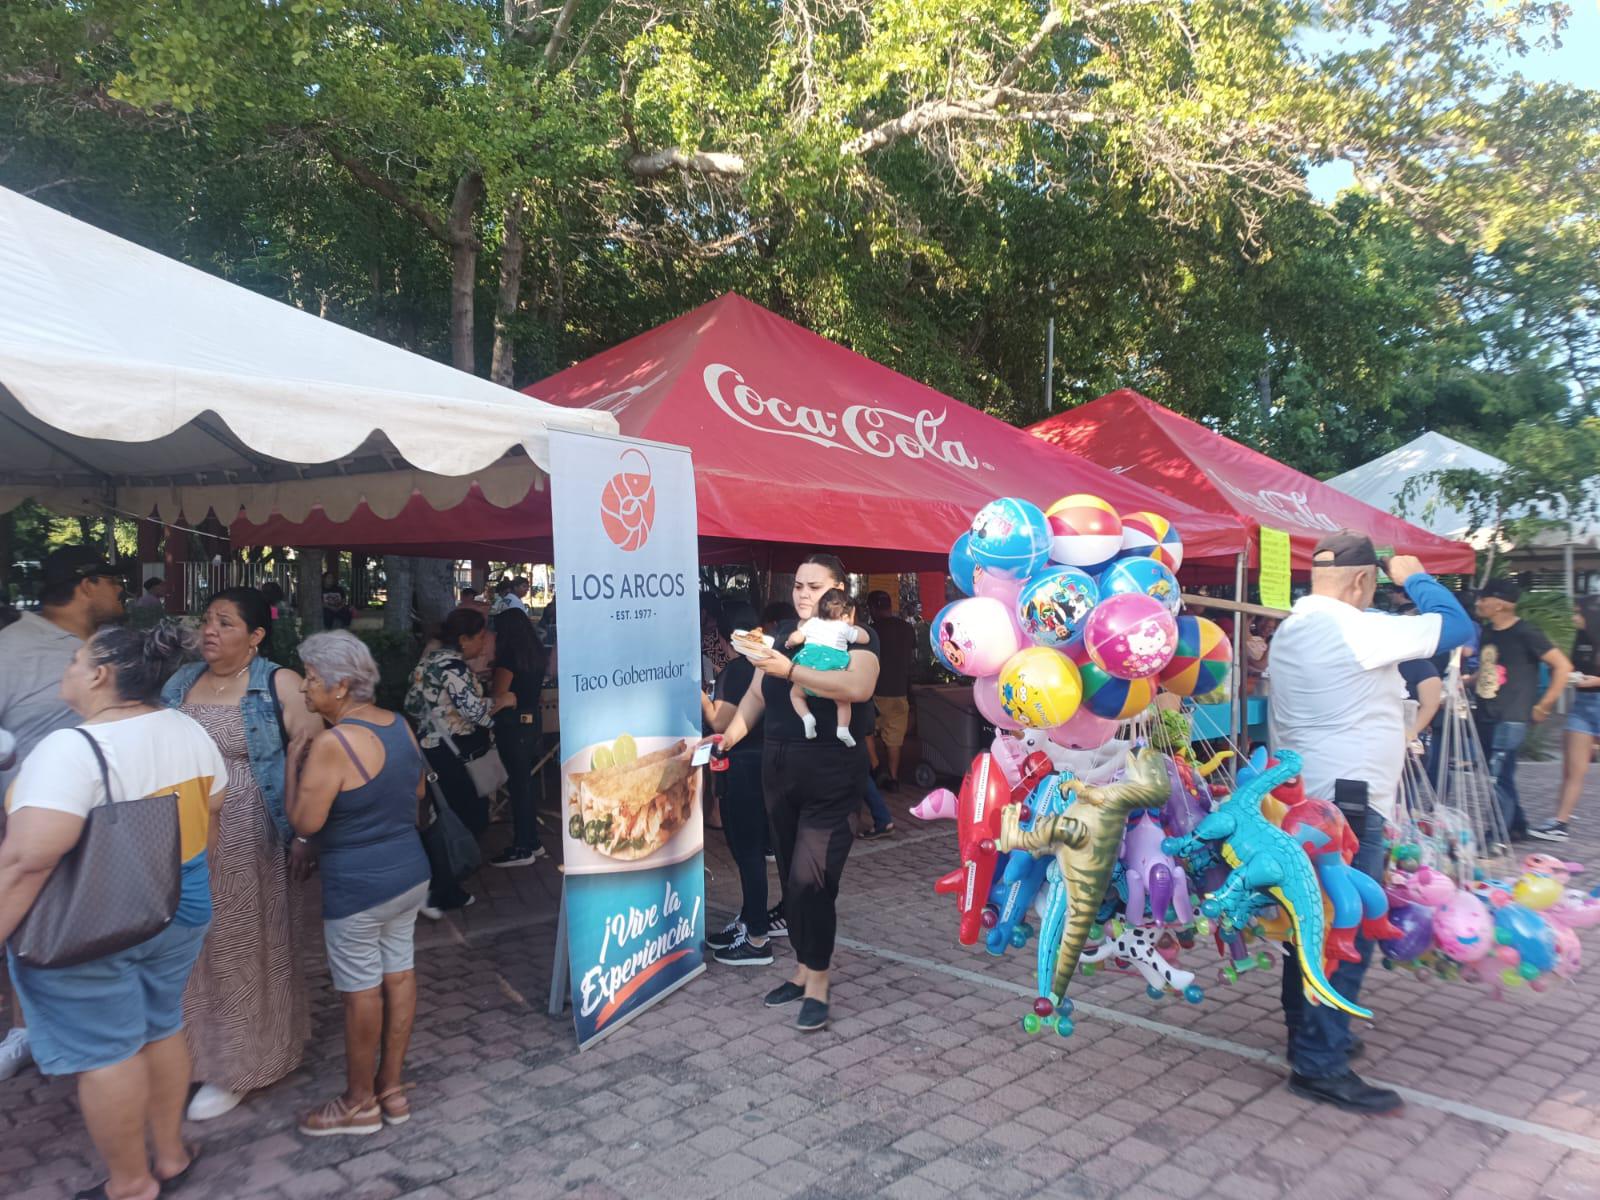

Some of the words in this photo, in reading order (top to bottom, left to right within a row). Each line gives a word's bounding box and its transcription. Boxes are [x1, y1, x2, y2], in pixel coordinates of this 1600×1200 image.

[703, 363, 979, 470] Coca-Cola
[571, 573, 615, 601] LOS
[620, 573, 685, 599] ARCOS
[616, 610, 632, 621] EST.
[634, 608, 652, 620] 1977
[572, 674, 608, 693] Taco
[612, 661, 685, 688] Gobernador
[599, 904, 658, 964] ¡Vive
[663, 881, 681, 917] la
[580, 896, 701, 1017] Experiencia!
